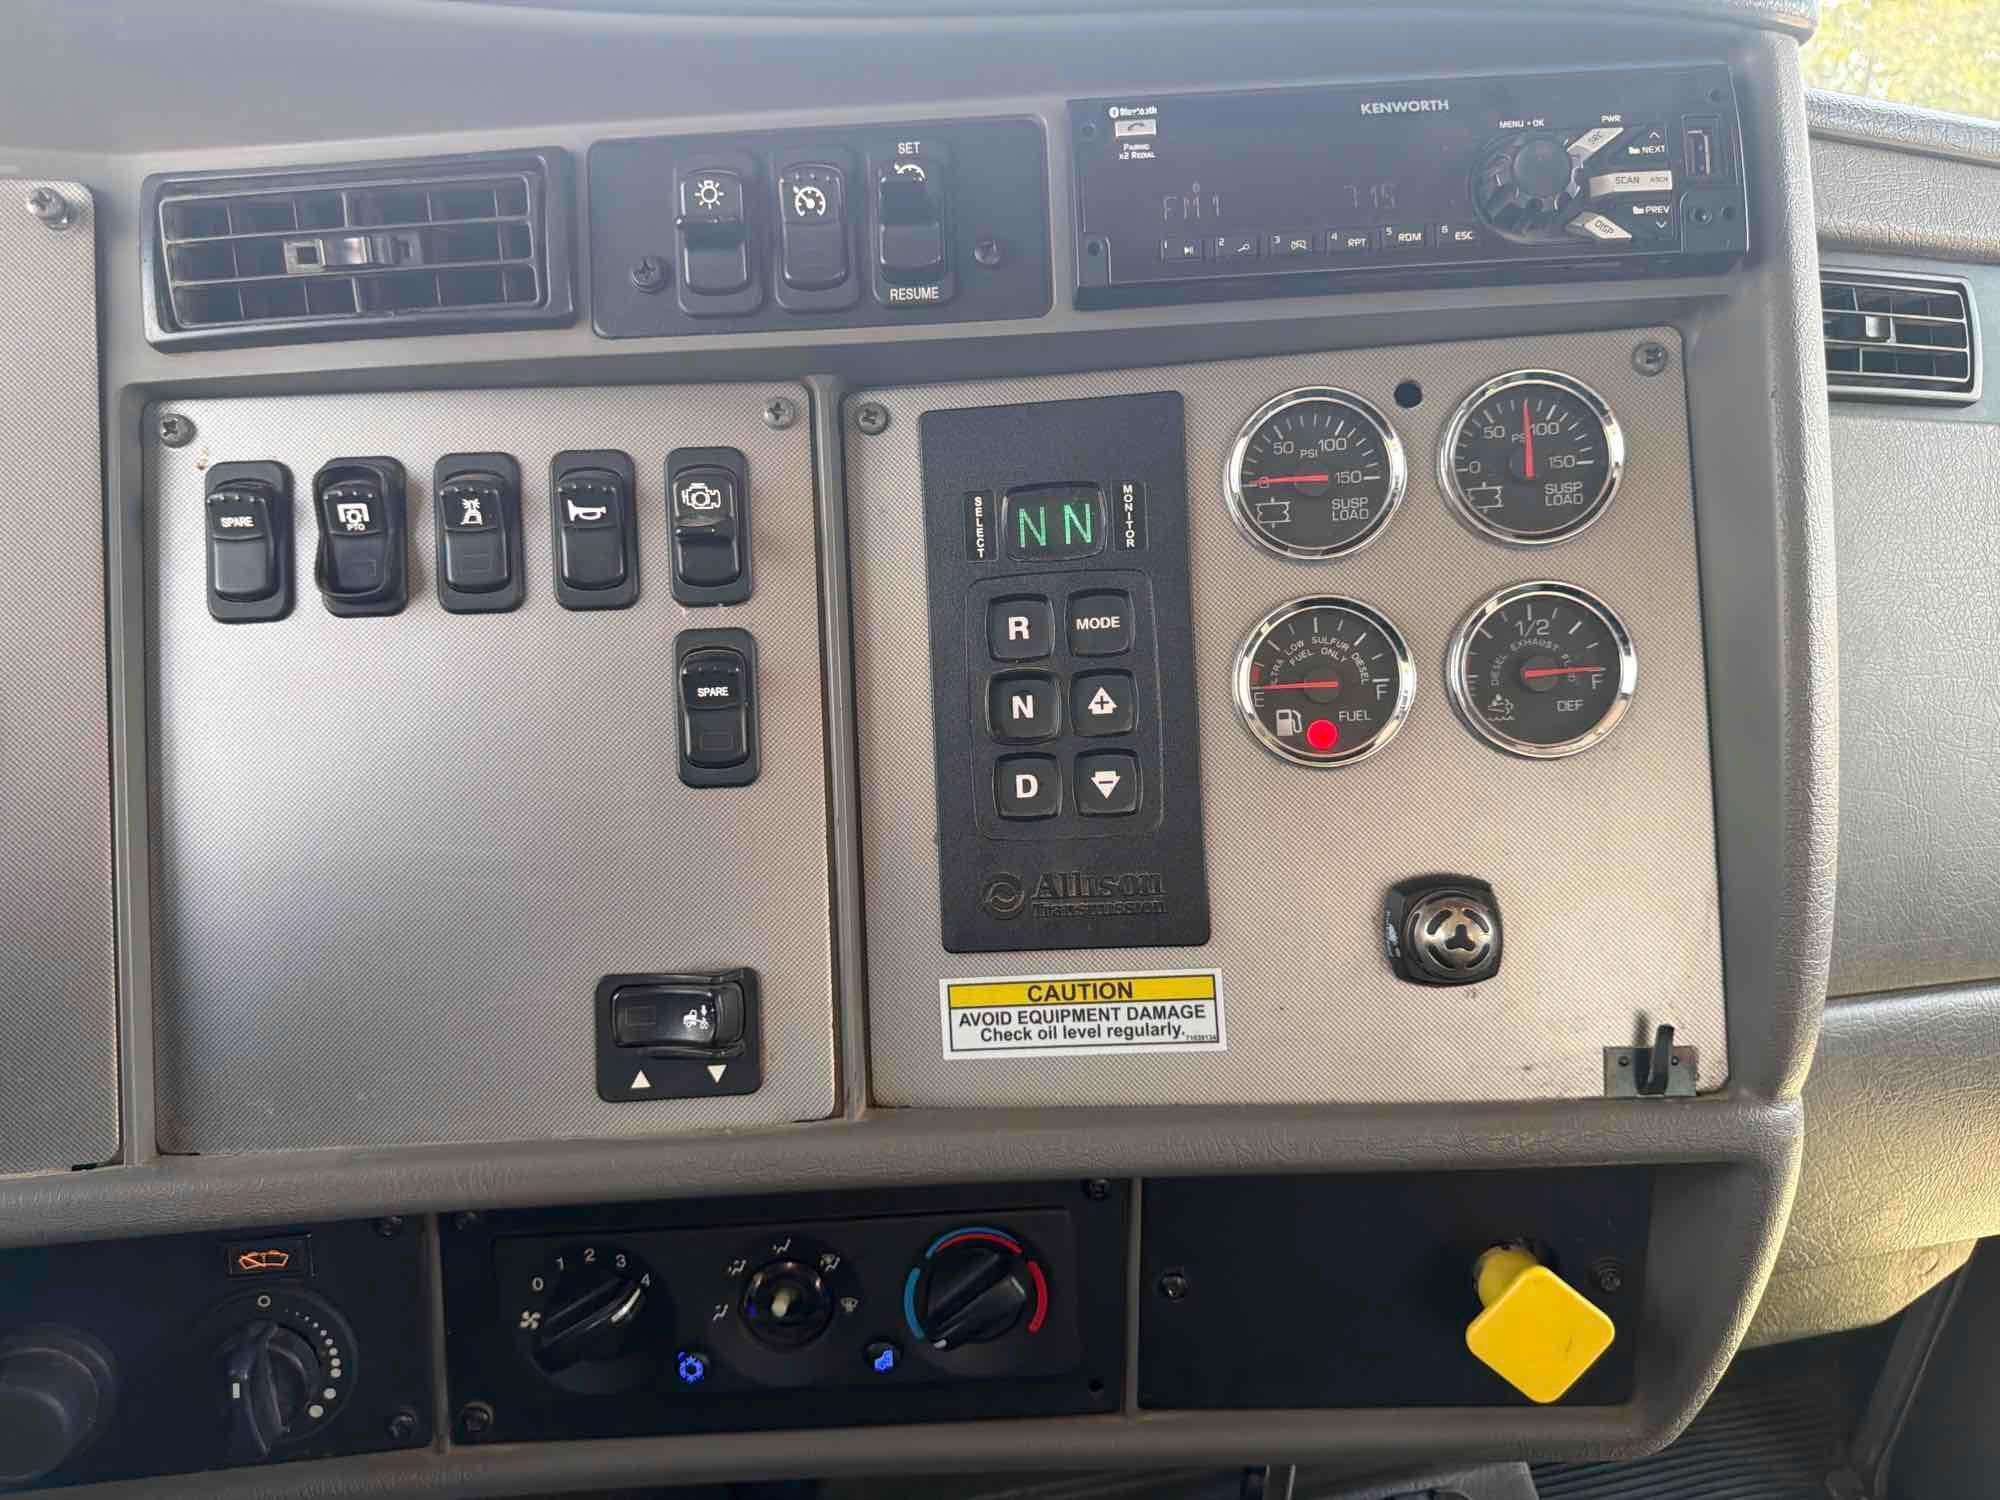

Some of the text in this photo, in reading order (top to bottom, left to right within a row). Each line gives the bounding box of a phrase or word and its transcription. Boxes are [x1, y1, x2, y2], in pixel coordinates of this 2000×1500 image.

[1360, 99, 1450, 116] KENWORTH
[1499, 119, 1544, 128] MENU OK
[1601, 114, 1621, 123] PWR
[897, 141, 921, 155] SET
[1642, 144, 1666, 153] NEXT
[1615, 176, 1640, 185] SCAN
[1645, 205, 1670, 214] PREV
[1385, 226, 1393, 236] 5
[1594, 219, 1615, 234] DISP
[1218, 237, 1225, 247] 2
[1274, 234, 1281, 244] 3
[1330, 231, 1338, 241] 4
[1347, 237, 1367, 247] RPT
[1454, 230, 1473, 240] ESC
[890, 286, 940, 302] RESUME
[1483, 425, 1505, 440] 50
[1529, 421, 1560, 437] 100
[1272, 440, 1295, 455] 50
[1318, 437, 1347, 452] 100
[1299, 448, 1319, 459] PSI
[1468, 460, 1481, 474] 0
[1549, 454, 1576, 469] 150
[1335, 470, 1363, 485] 150
[1544, 481, 1584, 495] SUSP
[1331, 497, 1369, 510] SUSP
[1544, 493, 1584, 507] LOAD
[220, 515, 255, 528] SPARE
[1122, 483, 1136, 548] MONITOR
[1331, 508, 1369, 521] LOAD
[346, 521, 366, 532] PTO
[974, 496, 985, 559] SELECT
[1017, 502, 1092, 549] N N
[1008, 616, 1031, 640] R
[1075, 615, 1121, 631] MODE
[1514, 619, 1550, 637] 1/2
[1284, 639, 1304, 656] LOW
[1311, 636, 1350, 652] SULFUR
[1288, 646, 1347, 666] FUEL ONLY
[1592, 673, 1604, 690] F
[697, 686, 729, 698] SPARE
[1254, 690, 1265, 708] E
[1376, 684, 1388, 700] F
[1012, 695, 1034, 719] N
[1556, 699, 1584, 712] DEF
[1338, 710, 1371, 722] FUEL
[1015, 774, 1039, 798] D
[1030, 871, 1167, 898] Allison
[1027, 982, 1133, 1002] CAUTION
[959, 1004, 1206, 1027] AVOID EQUIPMENT DAMAGE
[980, 1021, 1186, 1042] Check oil level regularly.
[584, 1248, 596, 1263] 2
[615, 1254, 627, 1268] 3
[556, 1256, 566, 1270] 1
[532, 1277, 544, 1291] 0
[641, 1273, 651, 1287] 4
